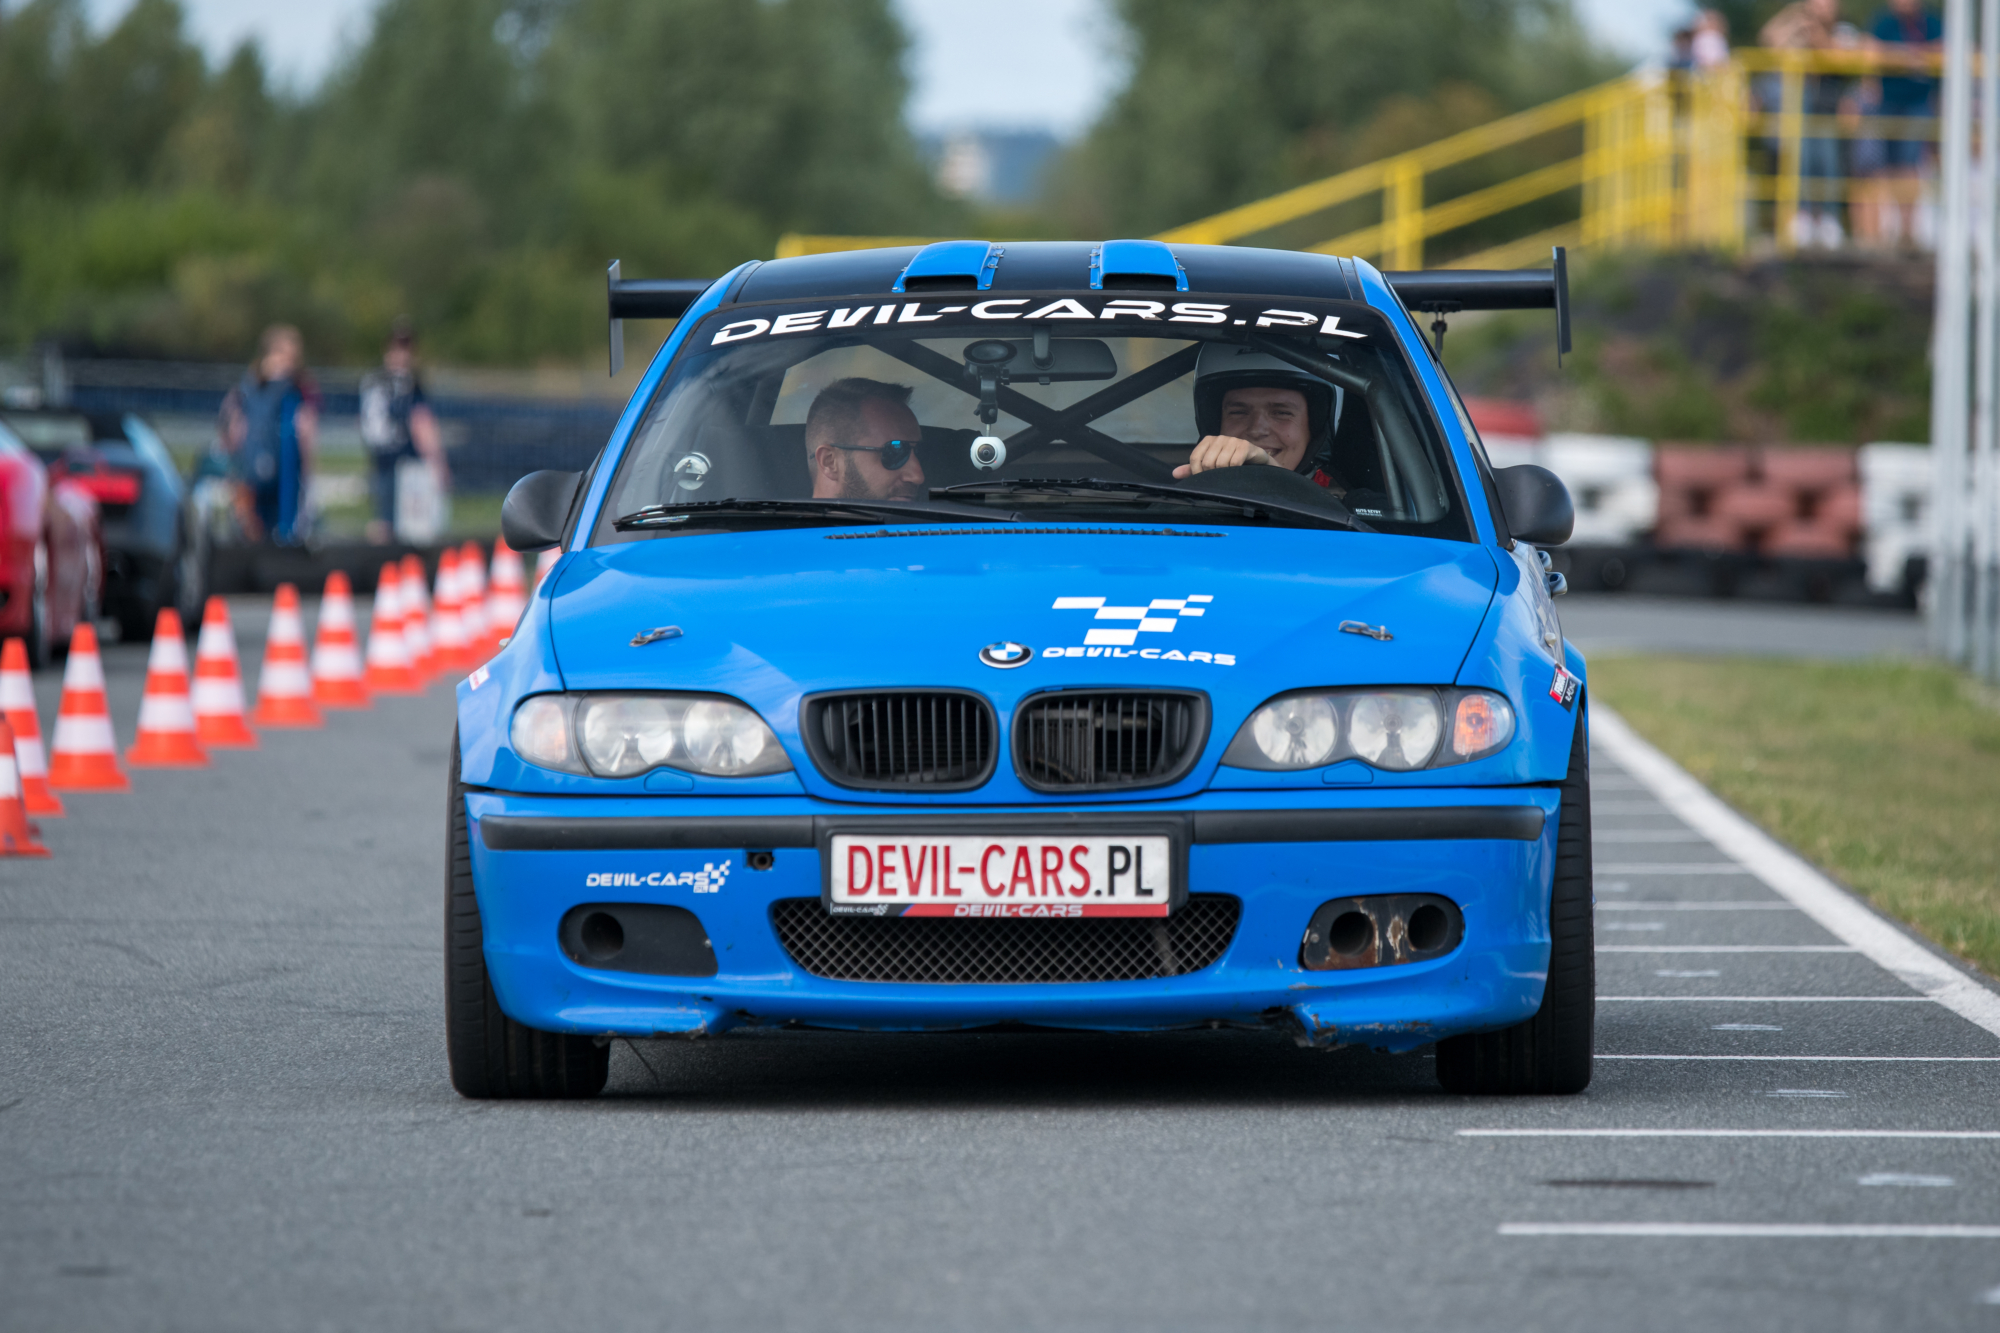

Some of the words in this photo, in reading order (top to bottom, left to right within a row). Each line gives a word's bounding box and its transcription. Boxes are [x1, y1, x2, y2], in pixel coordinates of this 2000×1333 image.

[711, 298, 1368, 346] DEVIL-CARS.PL
[1042, 647, 1236, 666] DEVIL-CARS
[586, 872, 709, 887] DEVIL-CARS
[847, 844, 1153, 897] DEVIL-CARS.PL
[954, 904, 1083, 917] DEVIL-CARS
